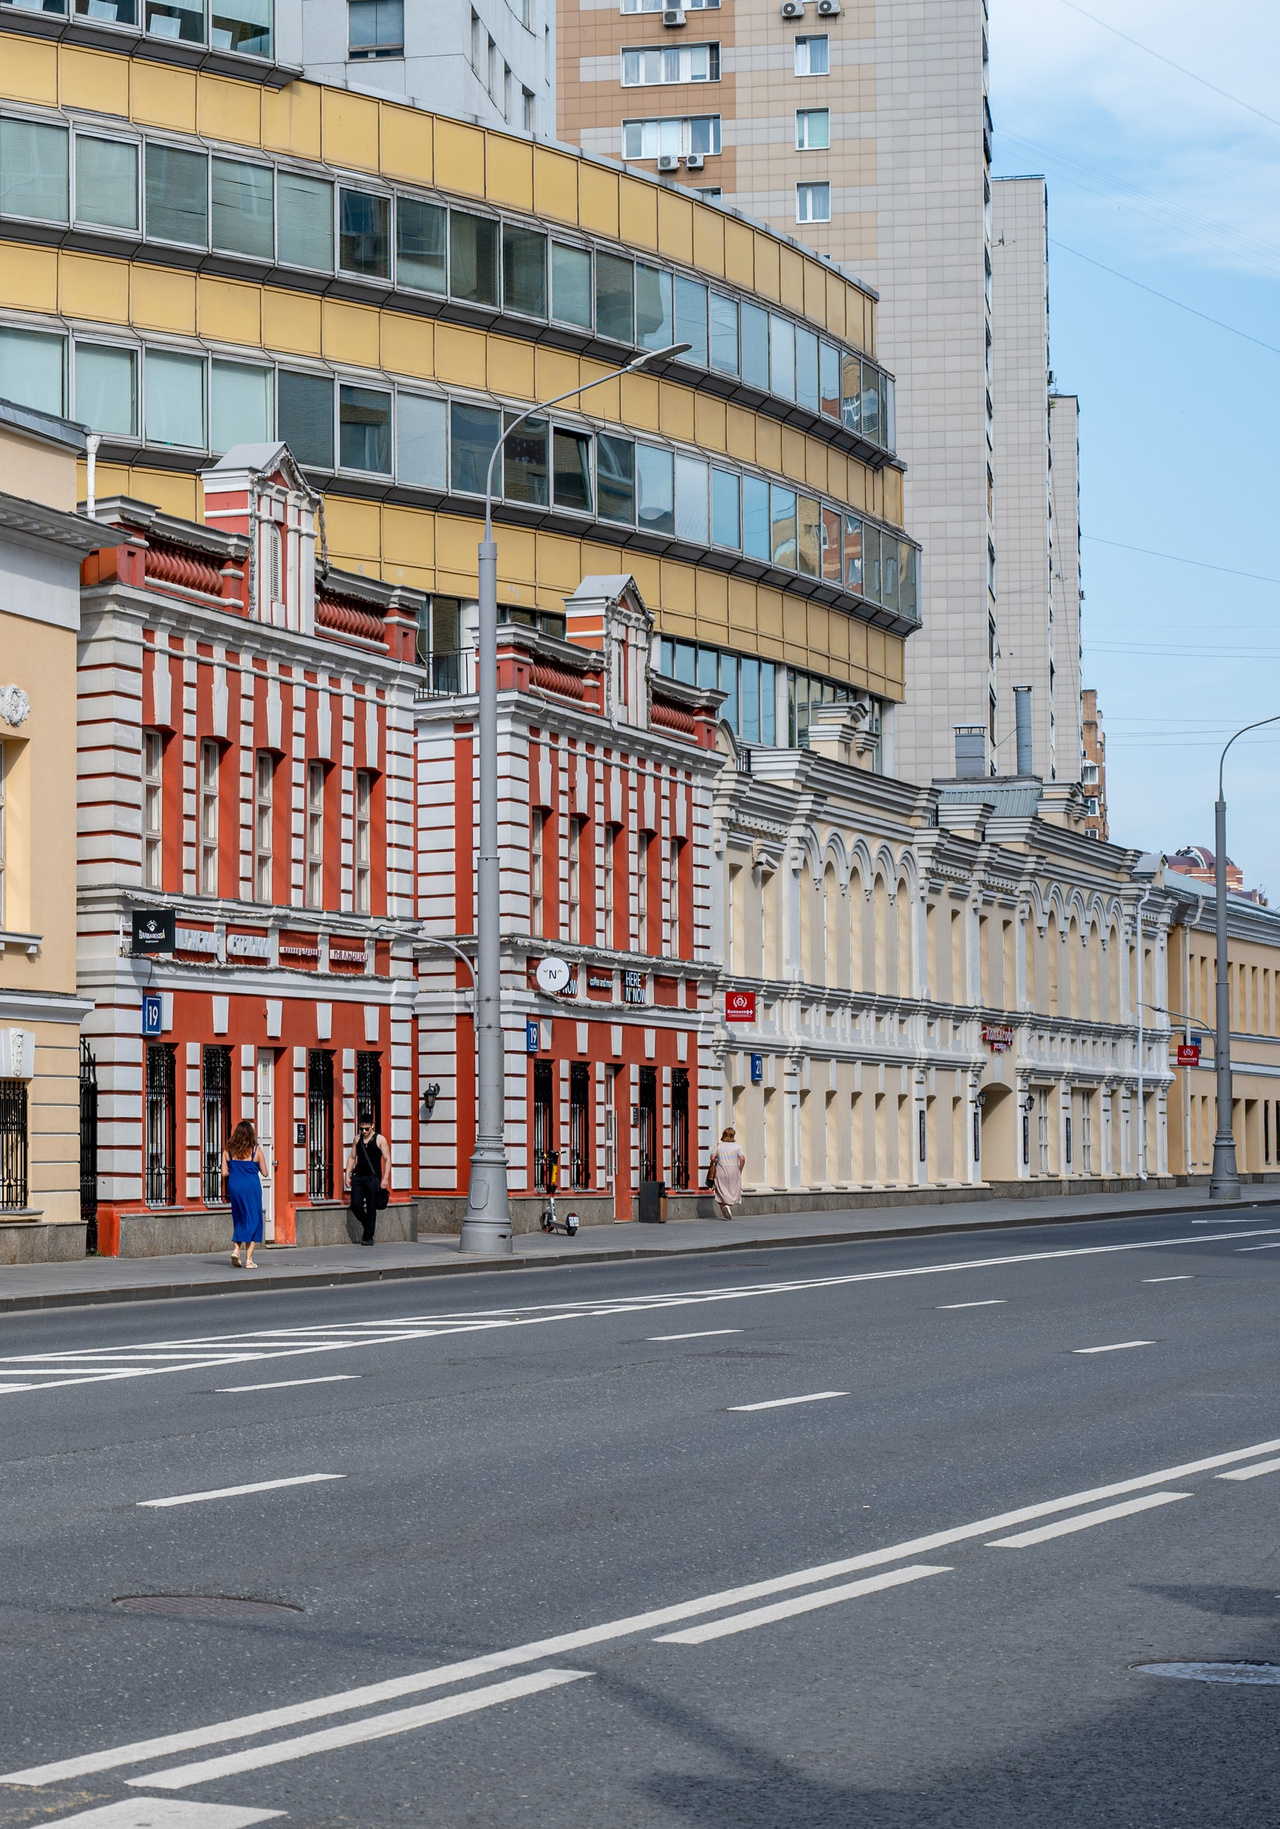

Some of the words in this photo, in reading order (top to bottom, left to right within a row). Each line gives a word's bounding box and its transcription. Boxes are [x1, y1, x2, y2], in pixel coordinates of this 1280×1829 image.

[148, 1005, 159, 1026] 19
[530, 1027, 538, 1044] 19
[755, 1060, 762, 1074] 21
